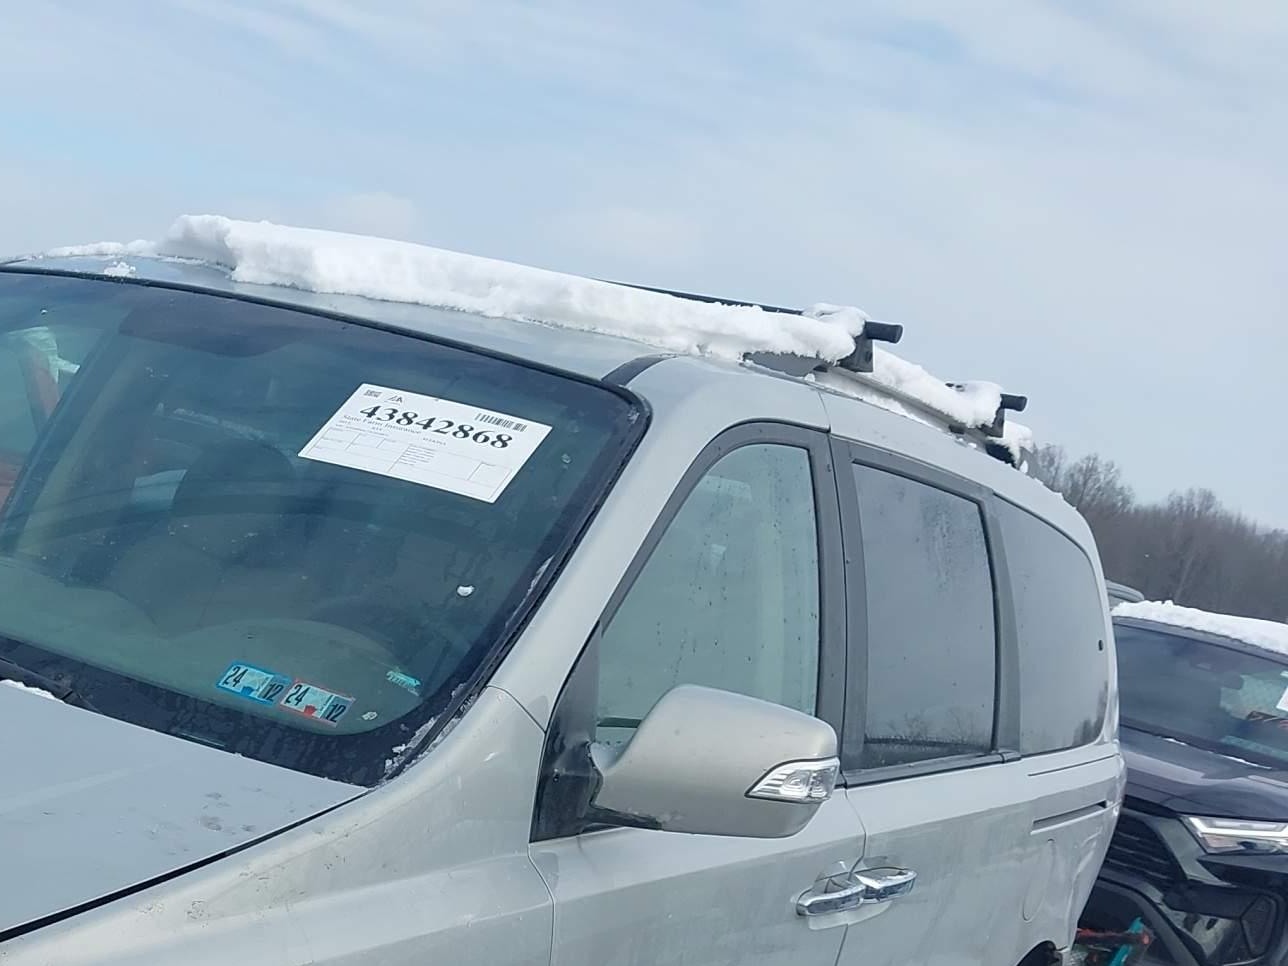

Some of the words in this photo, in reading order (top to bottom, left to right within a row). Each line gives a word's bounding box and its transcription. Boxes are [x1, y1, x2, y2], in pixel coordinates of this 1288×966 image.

[360, 405, 513, 449] 43842868
[223, 666, 249, 687] 24
[262, 683, 285, 702] 12
[285, 684, 310, 706] 24
[325, 703, 348, 723] 12
